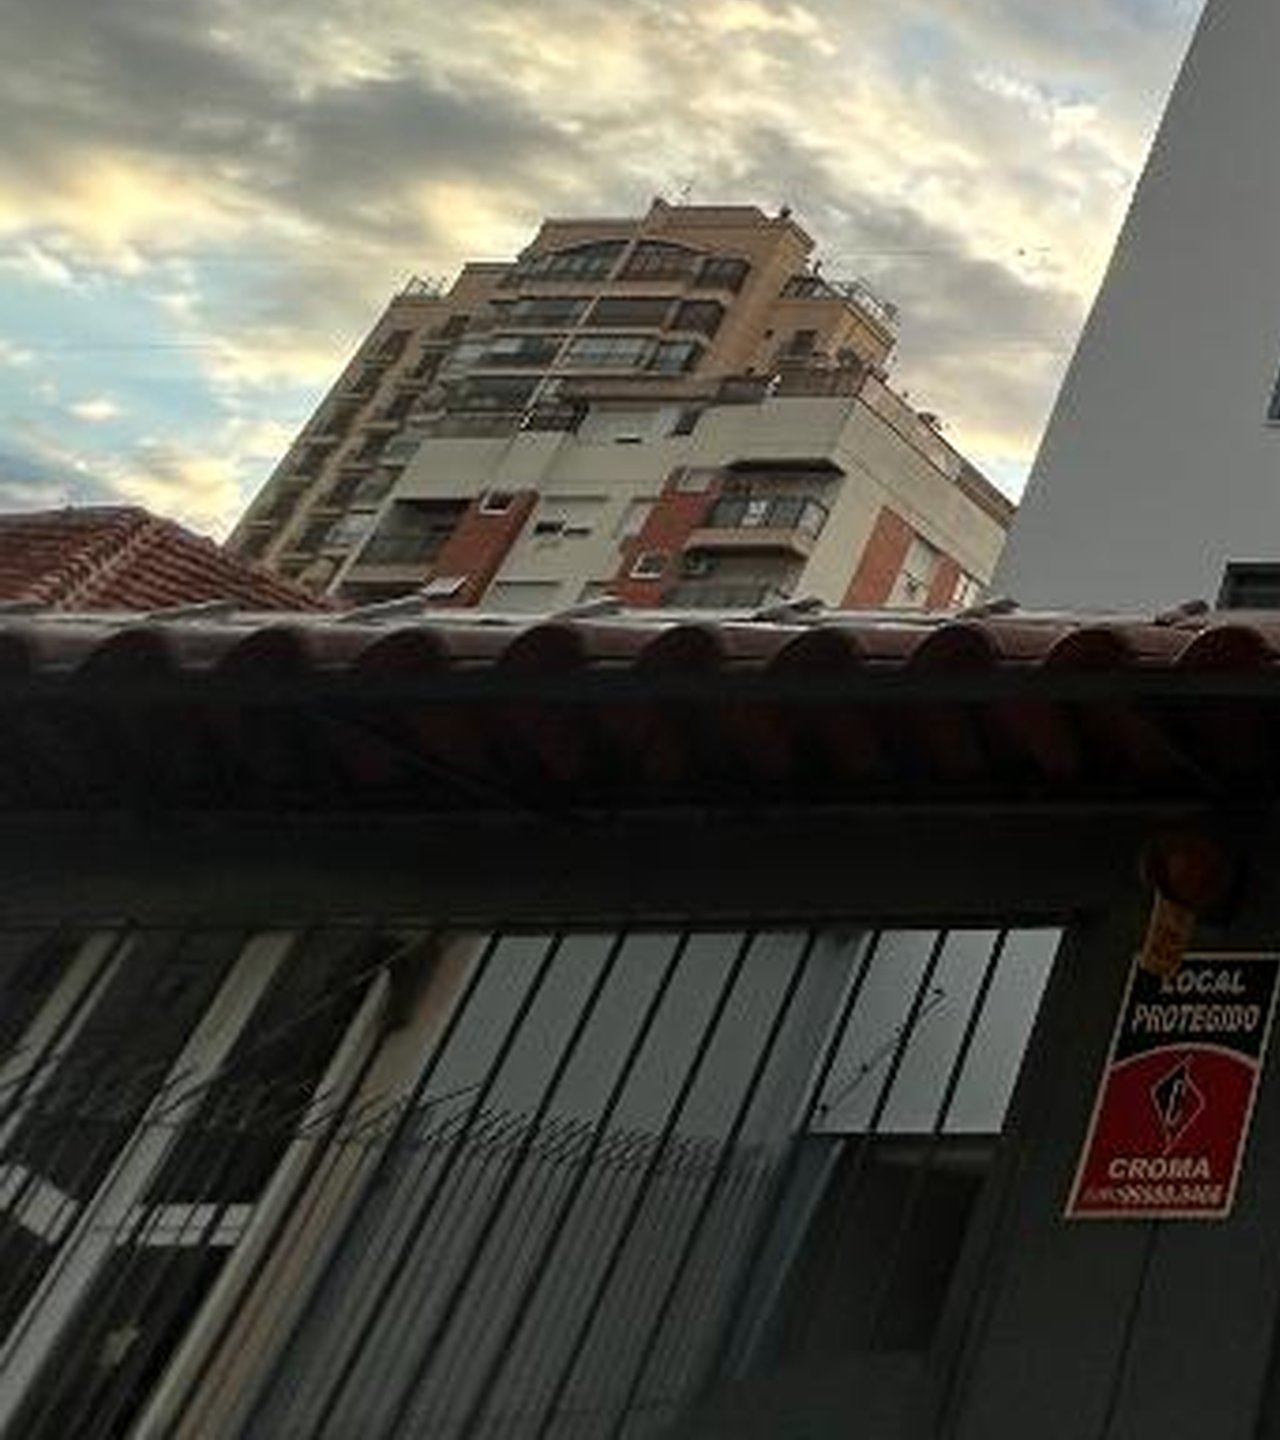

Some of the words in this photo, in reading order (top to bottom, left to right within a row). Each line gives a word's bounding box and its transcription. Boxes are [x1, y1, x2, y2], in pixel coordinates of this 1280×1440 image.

[1158, 968, 1247, 996] LOCAL
[1130, 1002, 1262, 1034] PROTEGIDO
[1107, 1156, 1211, 1180] CROMA
